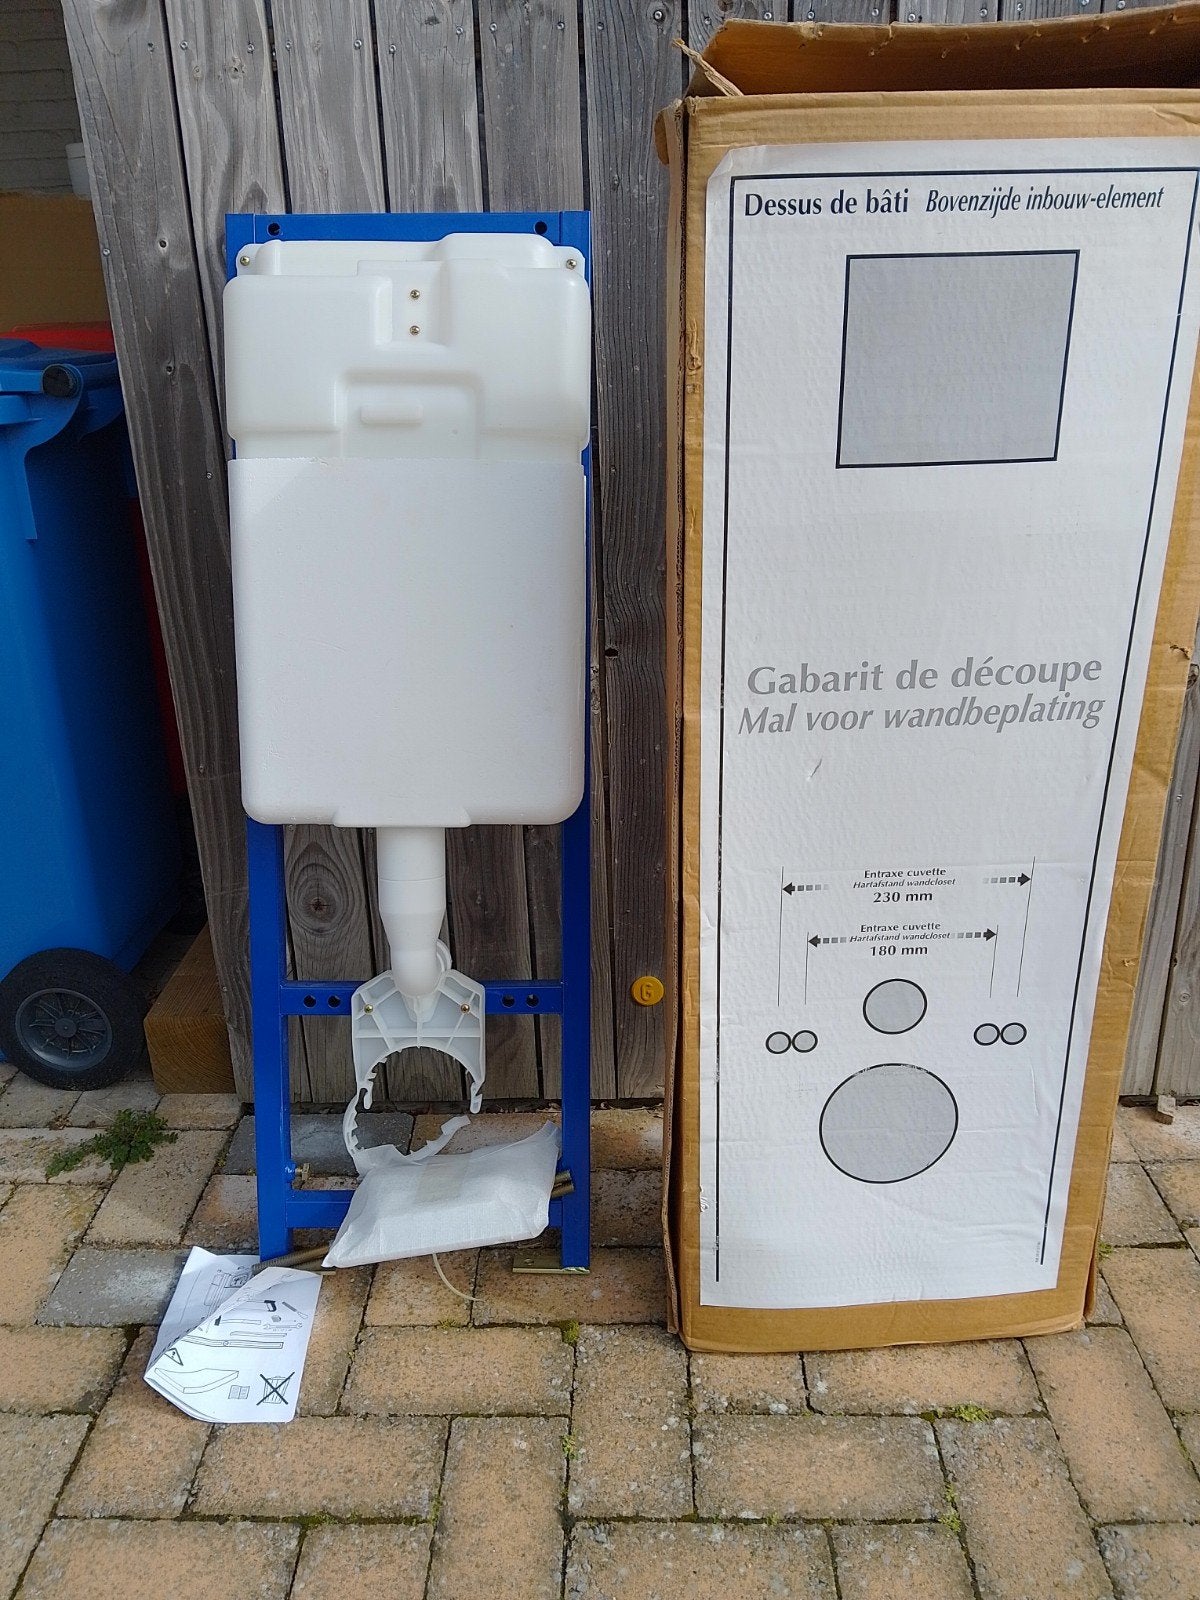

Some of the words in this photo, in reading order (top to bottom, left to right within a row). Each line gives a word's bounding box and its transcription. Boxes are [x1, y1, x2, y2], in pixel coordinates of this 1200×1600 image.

[745, 193, 822, 216] Dessus
[831, 190, 858, 214] de
[866, 188, 908, 214] bâti
[926, 186, 1020, 218] Bovenzijde
[1026, 184, 1165, 210] inbouw-element
[748, 660, 883, 695] Gabarit
[896, 659, 938, 690] de
[951, 656, 1102, 691] découpe
[738, 702, 798, 735] Mal
[806, 707, 873, 732] voor
[885, 691, 1105, 734] wandbeplating
[864, 869, 904, 879] Entraxe
[907, 867, 947, 877] cuvette
[853, 879, 905, 889] Hartafstand
[907, 878, 956, 887] wandcloset
[873, 891, 901, 903] 230
[905, 892, 933, 902] mm
[860, 924, 900, 933] Entraxe
[902, 922, 941, 931] cuvette
[850, 933, 901, 943] Hartafstand
[902, 932, 951, 940] wandcloset
[871, 945, 897, 956] 180
[901, 946, 928, 955] mm
